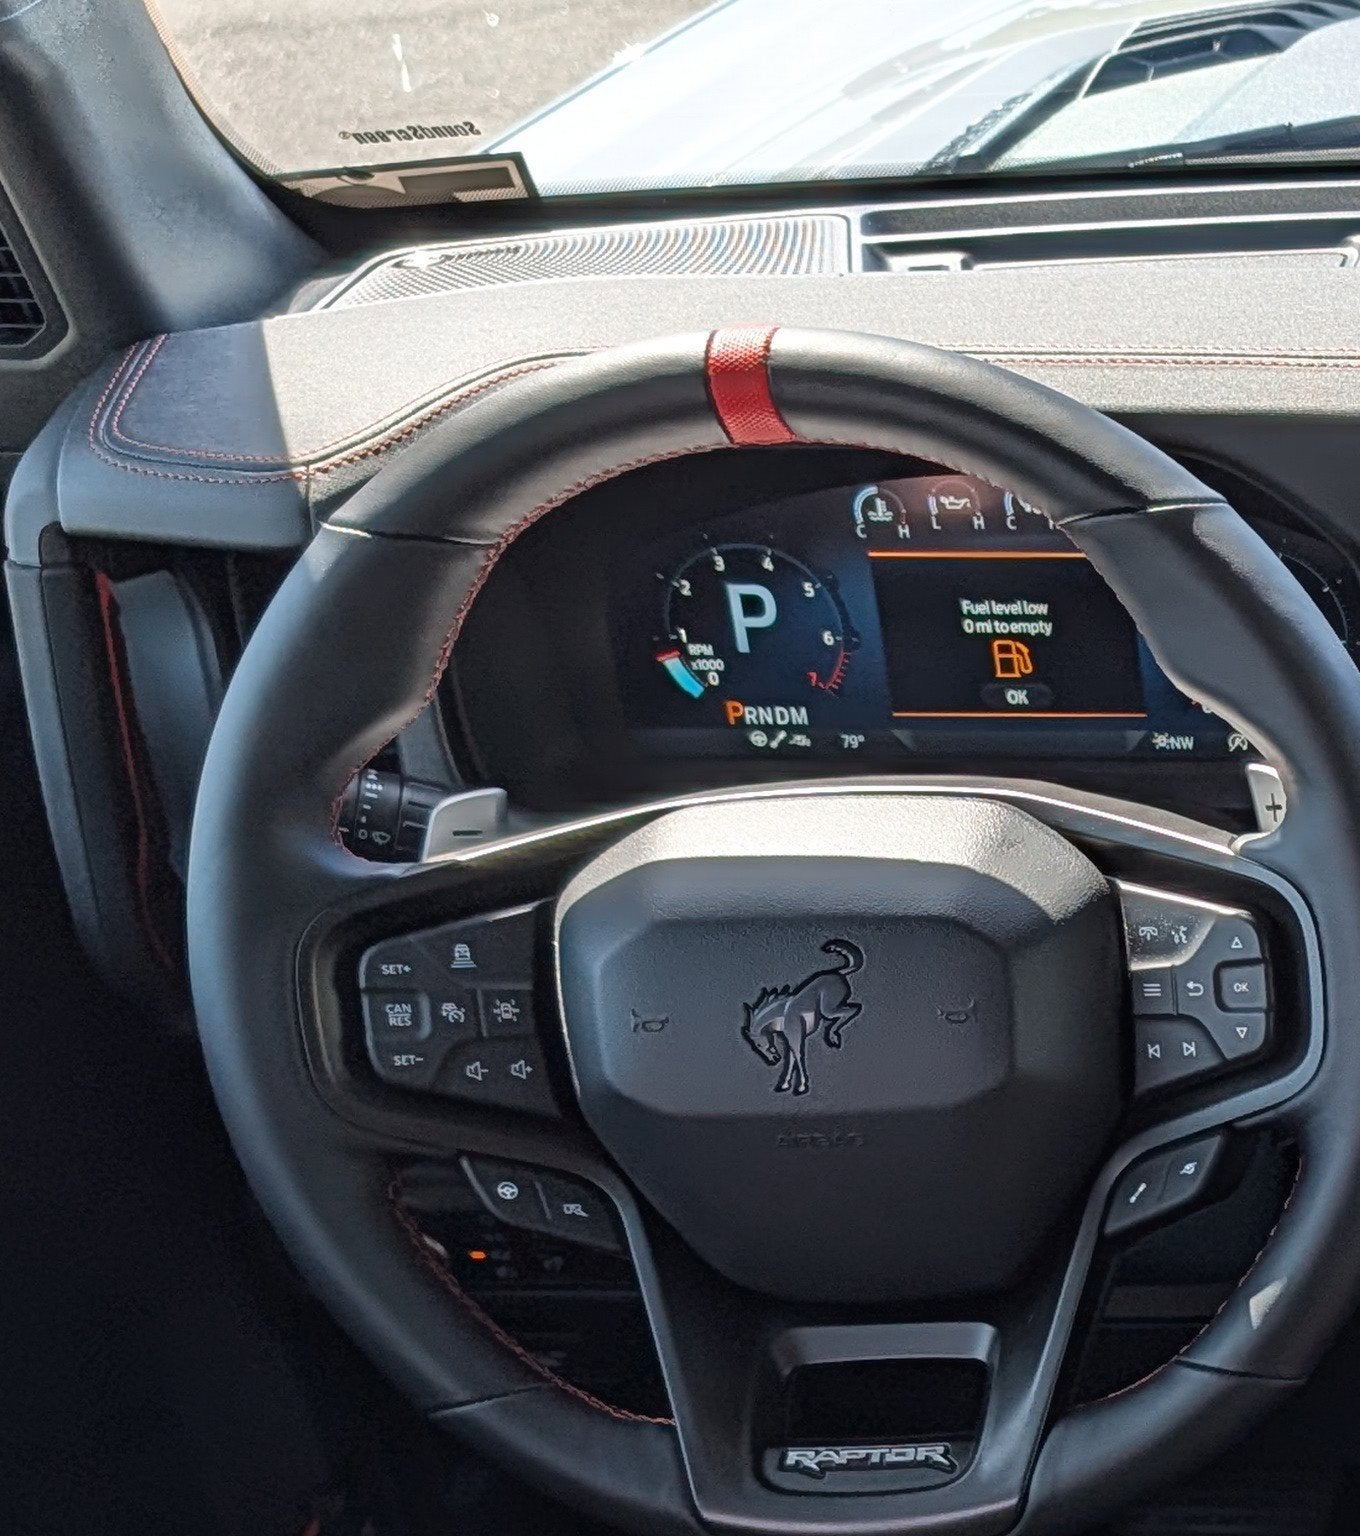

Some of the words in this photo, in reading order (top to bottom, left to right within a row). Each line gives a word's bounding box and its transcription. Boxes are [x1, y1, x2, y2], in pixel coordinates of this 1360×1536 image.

[931, 515, 942, 531] L
[972, 515, 986, 530] H
[1006, 515, 1018, 531] C
[898, 524, 911, 540] H
[713, 555, 725, 572] 3
[762, 556, 774, 572] 4
[680, 579, 692, 596] 2
[802, 581, 815, 598] 5
[960, 599, 991, 615] Fuel
[991, 600, 1022, 615] level
[1023, 600, 1049, 615] low
[725, 583, 777, 654] P
[678, 627, 687, 644] 1
[963, 619, 974, 633] 0
[976, 619, 993, 633] mi
[994, 620, 1009, 634] to
[1010, 621, 1053, 637] empty
[822, 630, 835, 646] 6
[687, 643, 714, 656] RPM
[707, 671, 720, 686] 0
[807, 671, 818, 686] 7
[1005, 689, 1029, 705] OK
[1234, 982, 1249, 993] OK
[386, 1004, 412, 1015] CAN
[785, 1445, 956, 1474] RAPTOR
